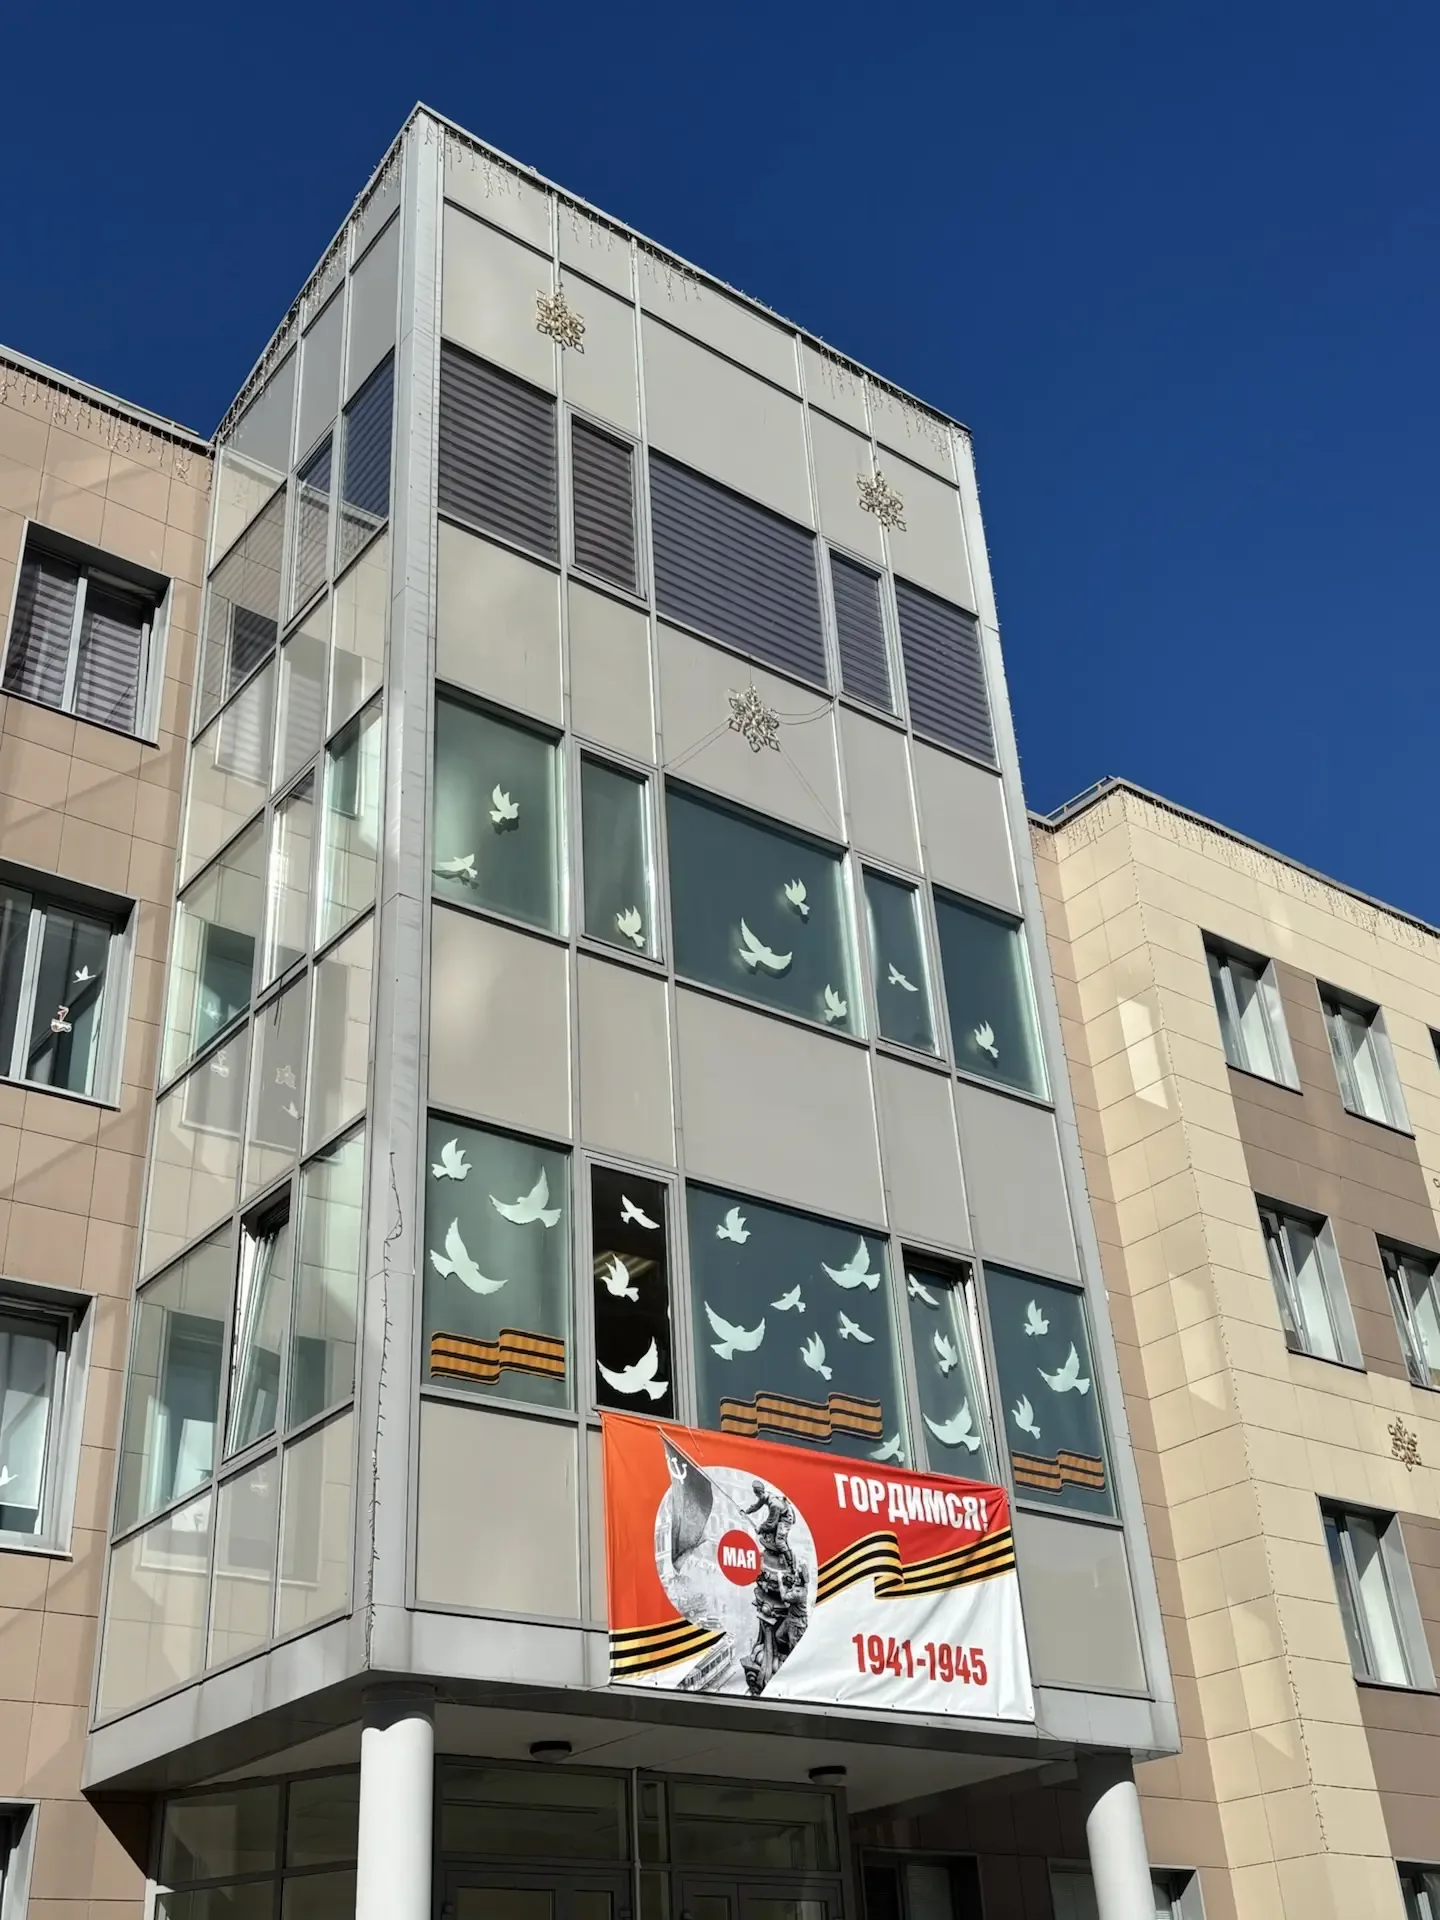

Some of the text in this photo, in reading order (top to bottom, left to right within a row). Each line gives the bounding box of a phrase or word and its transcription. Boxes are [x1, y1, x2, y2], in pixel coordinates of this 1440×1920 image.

[834, 1473, 988, 1531] ГОРДИМСЯ!
[722, 1545, 757, 1570] МАЯ
[851, 1633, 988, 1686] 1941-1945
